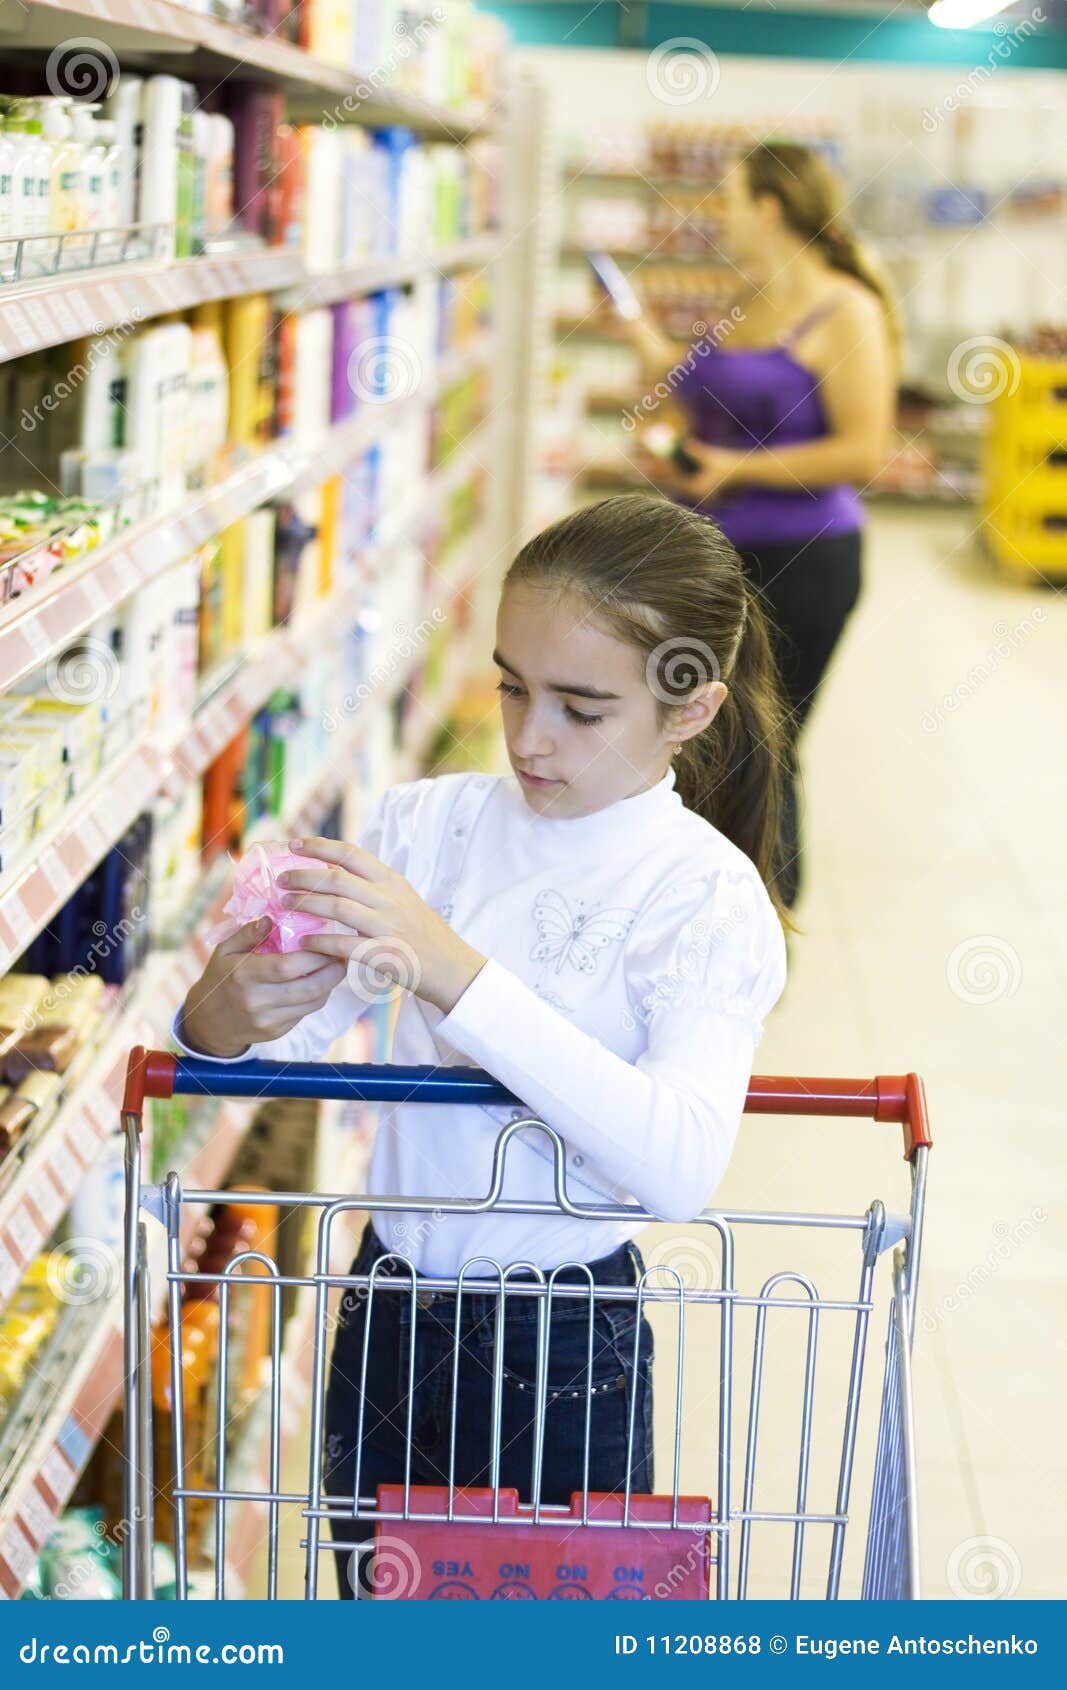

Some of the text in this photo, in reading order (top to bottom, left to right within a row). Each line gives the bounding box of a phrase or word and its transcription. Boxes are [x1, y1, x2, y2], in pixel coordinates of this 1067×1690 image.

[432, 1561, 645, 1583] NO NO NO YES
